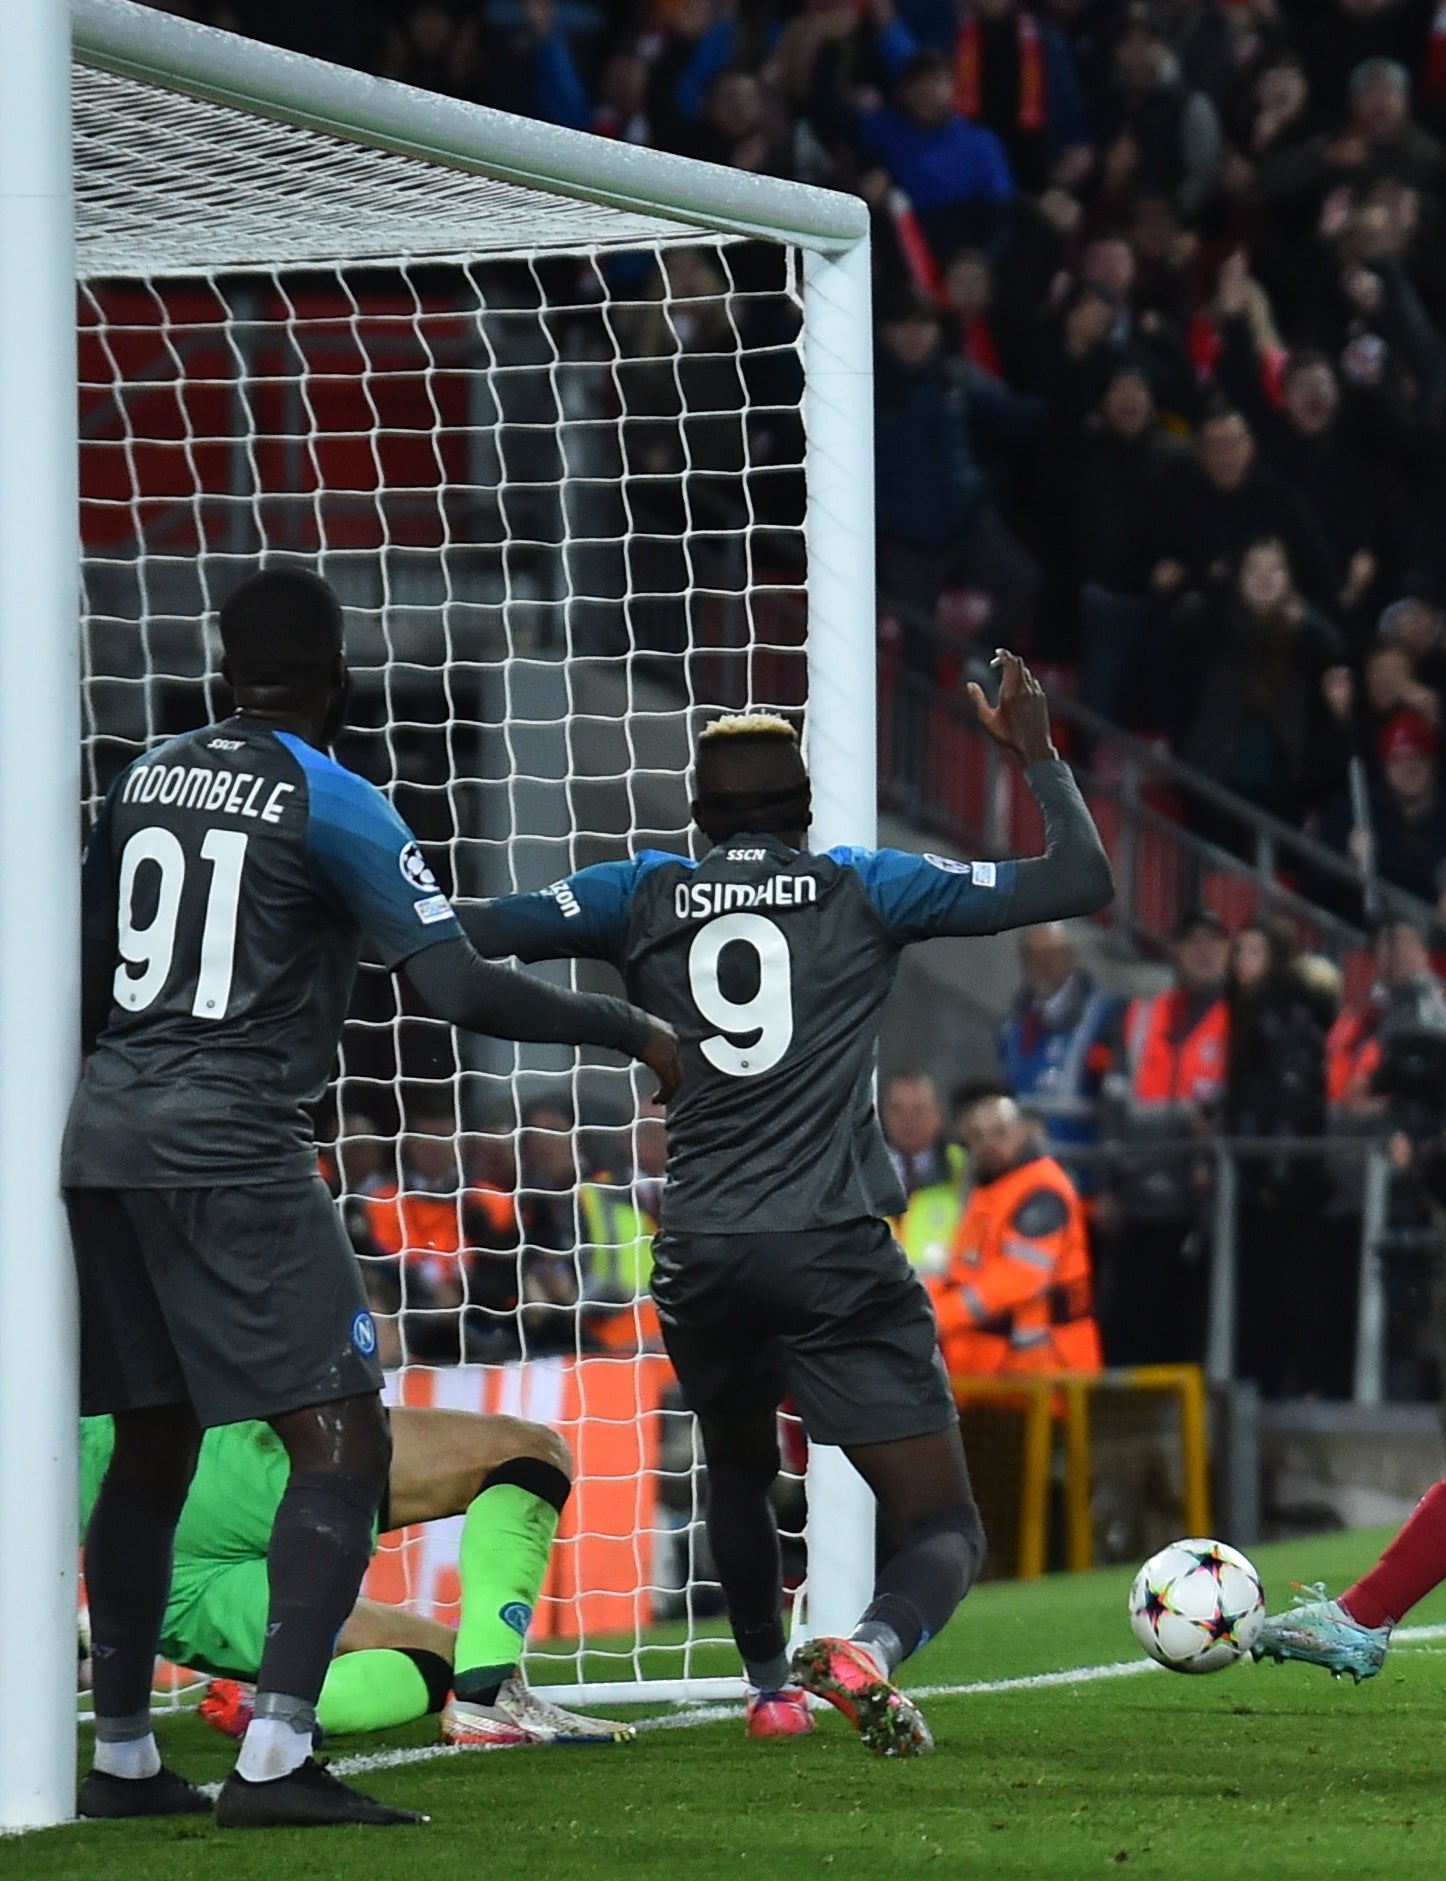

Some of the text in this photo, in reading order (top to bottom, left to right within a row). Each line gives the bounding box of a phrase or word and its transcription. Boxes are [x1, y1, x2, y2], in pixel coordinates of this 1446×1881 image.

[122, 764, 295, 824] NDOMBELE
[726, 849, 766, 861] SSCN
[548, 879, 581, 918] zon
[675, 874, 817, 919] OSIMHEN
[113, 826, 249, 1020] 91
[689, 912, 793, 1077] 9
